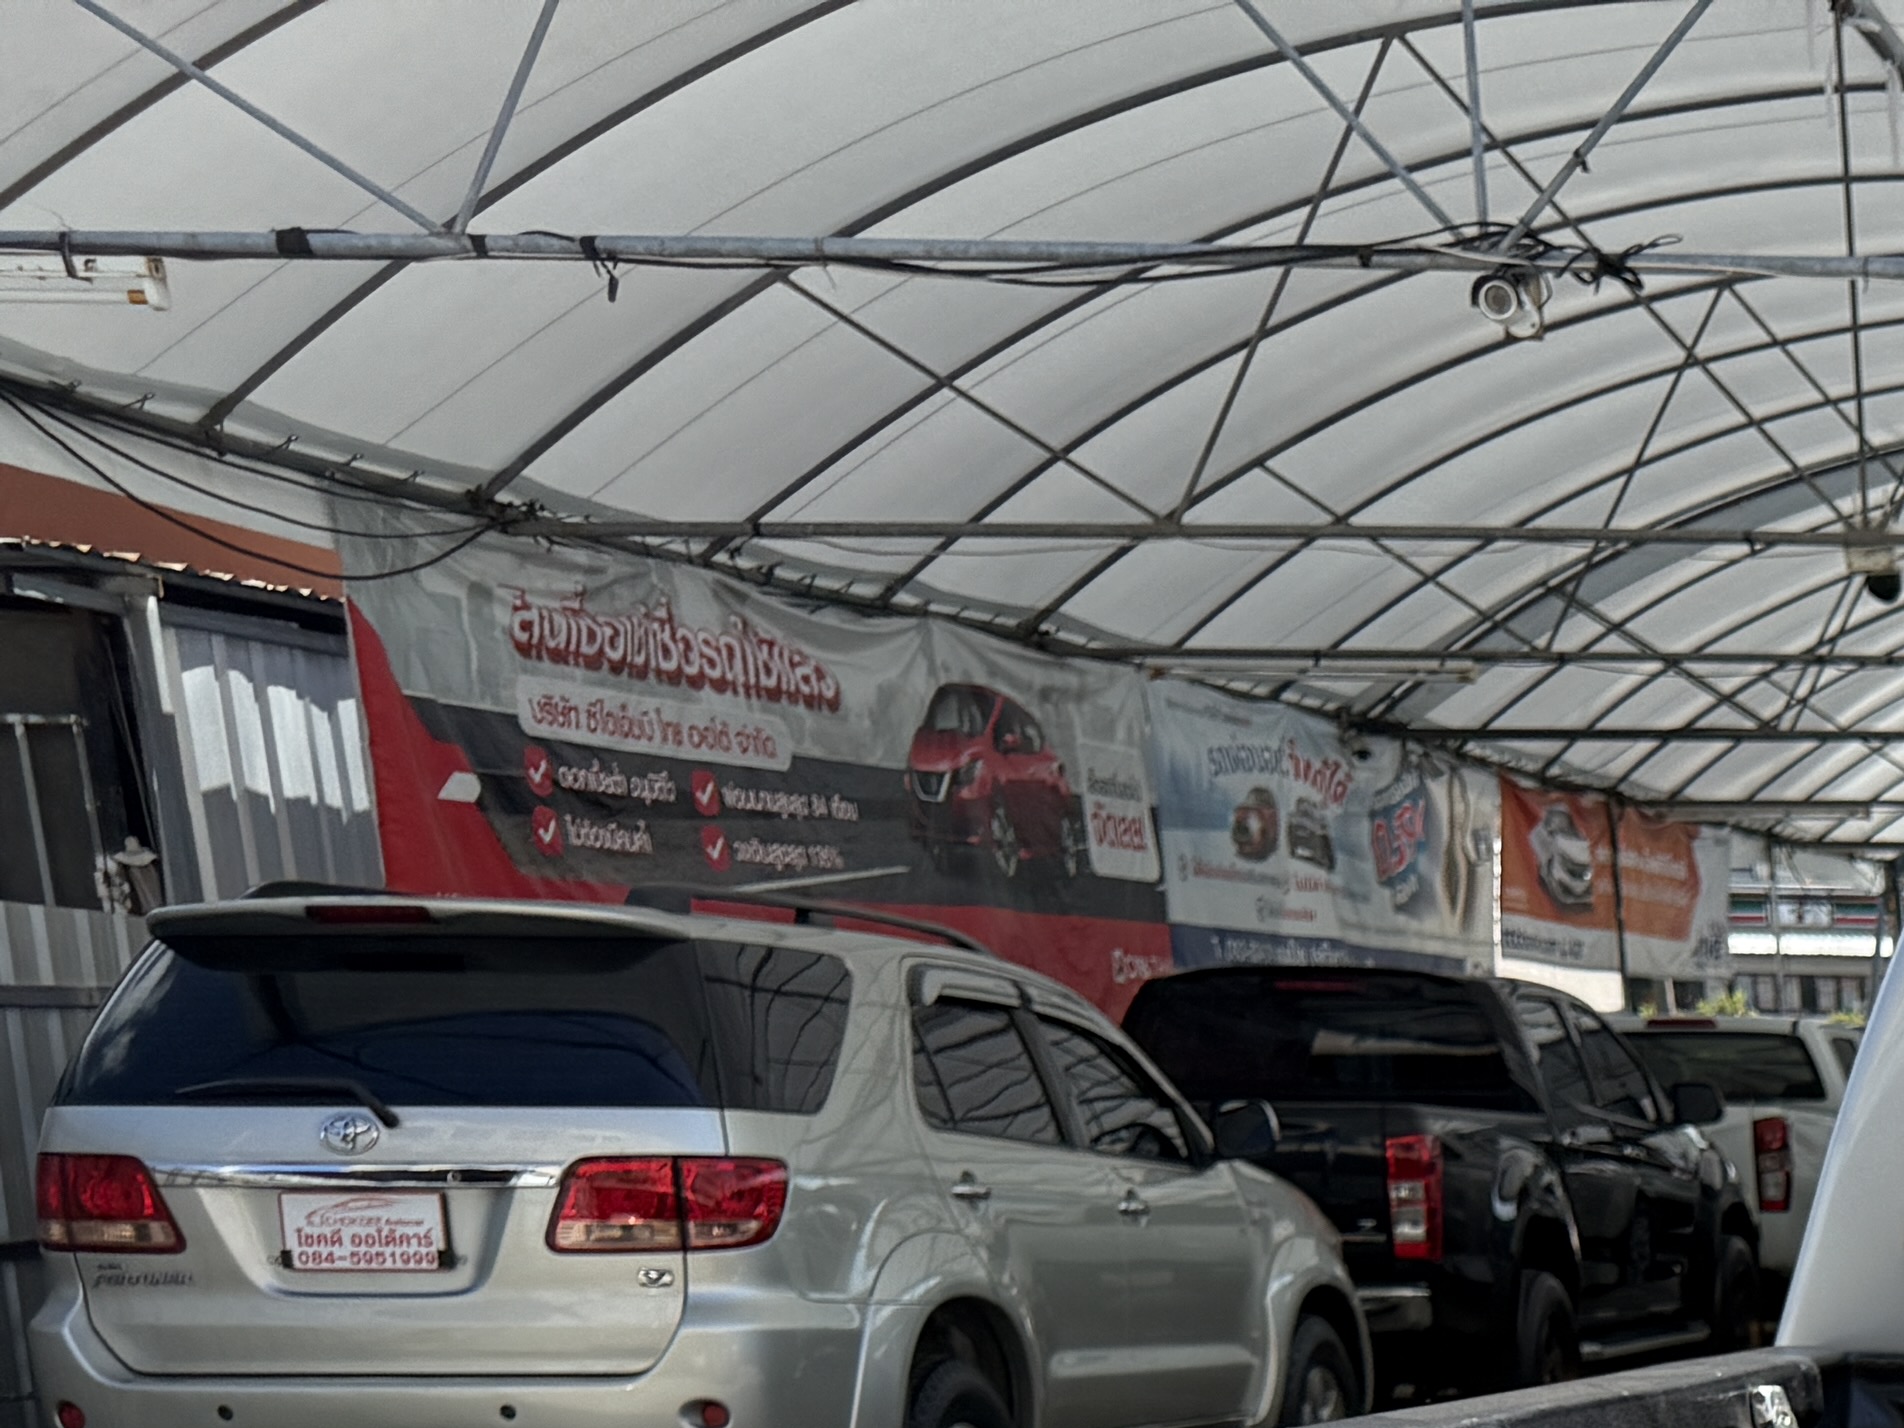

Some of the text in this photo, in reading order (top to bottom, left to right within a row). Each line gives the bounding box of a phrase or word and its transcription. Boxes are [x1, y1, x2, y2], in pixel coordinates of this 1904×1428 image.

[295, 1226, 434, 1249] โชคดี ออโต้คาร์
